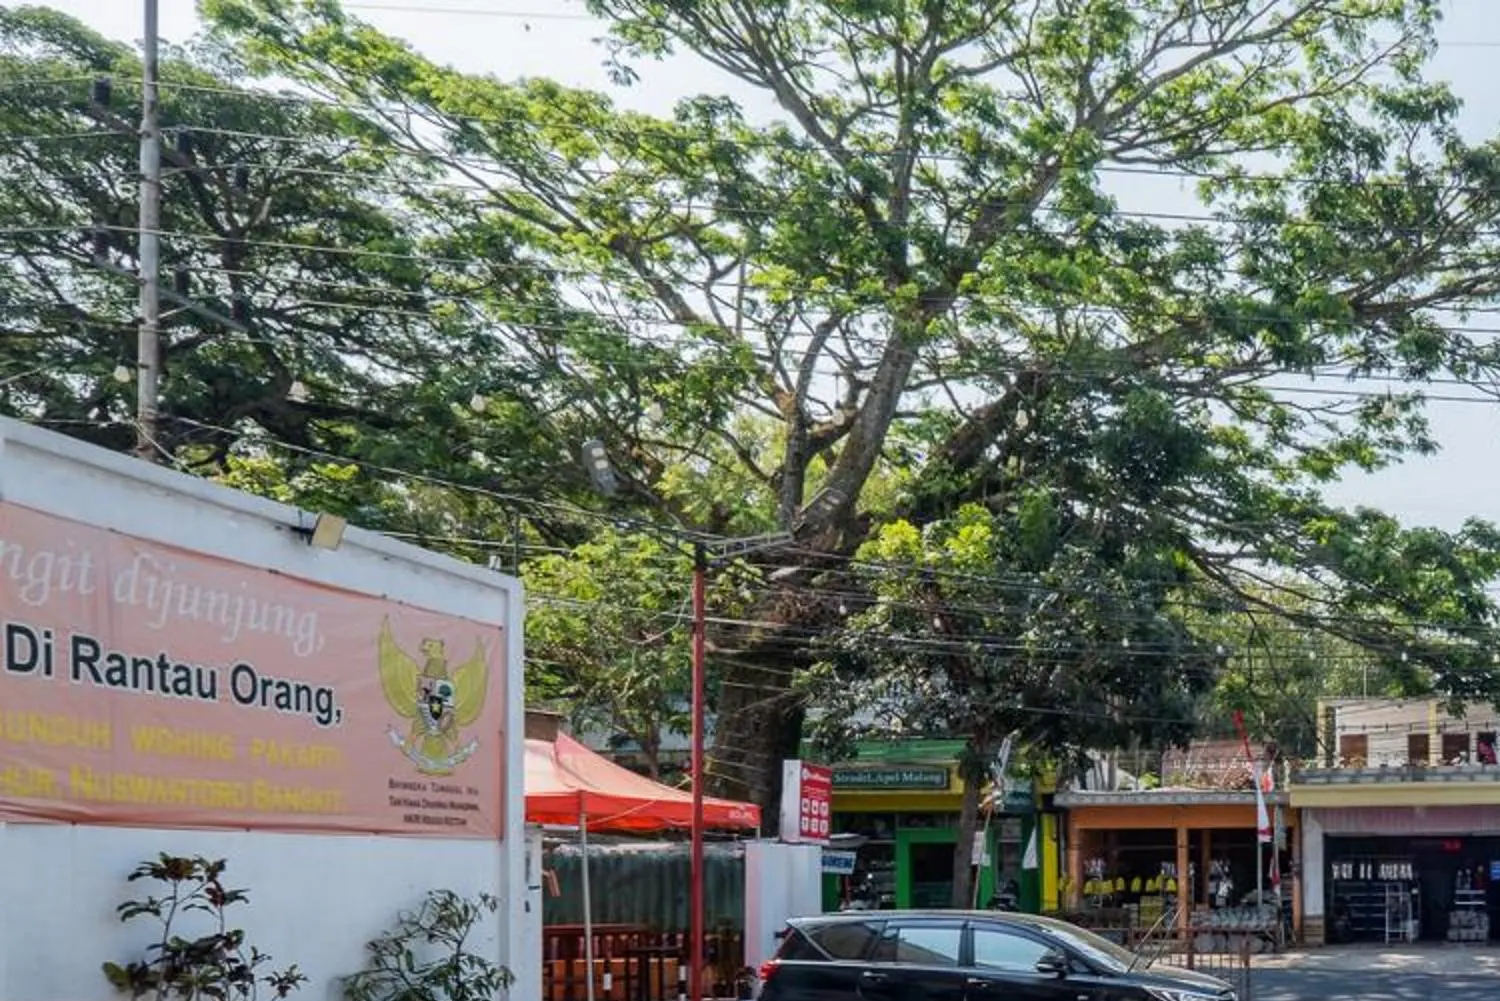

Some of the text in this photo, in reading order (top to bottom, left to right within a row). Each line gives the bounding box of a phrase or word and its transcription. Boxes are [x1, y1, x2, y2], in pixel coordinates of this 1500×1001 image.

[114, 550, 325, 657] dijunjung,
[6, 623, 342, 726] Di Rantau Orang,
